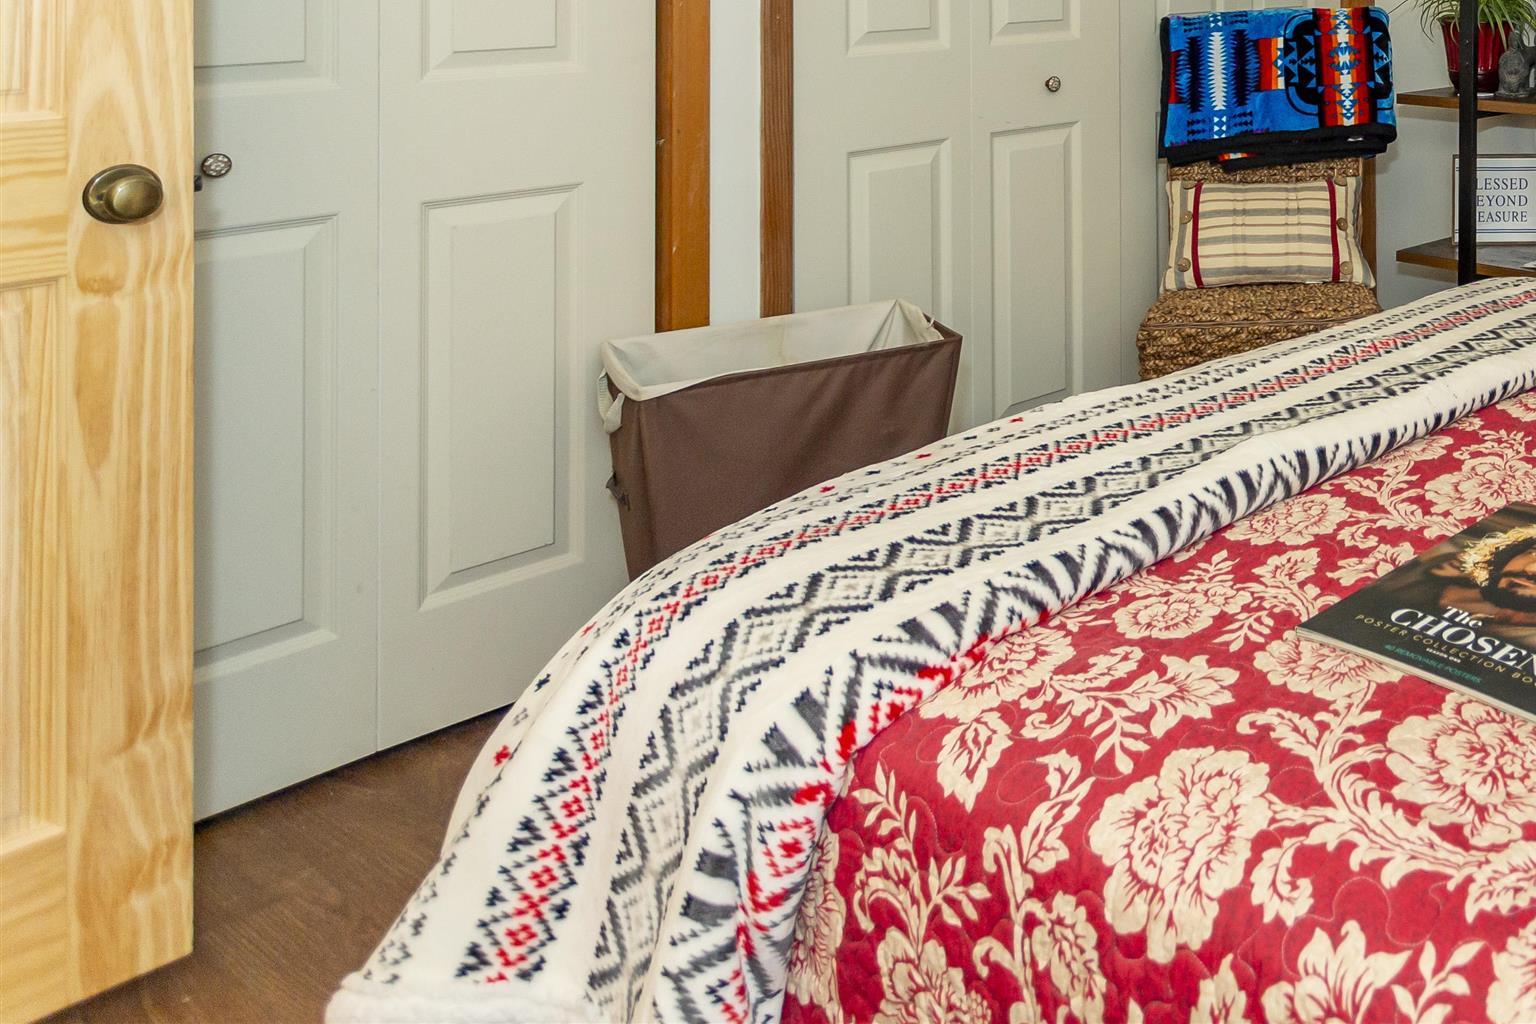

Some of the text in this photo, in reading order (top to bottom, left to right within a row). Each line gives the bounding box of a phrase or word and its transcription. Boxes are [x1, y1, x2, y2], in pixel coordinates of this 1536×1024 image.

[1476, 178, 1529, 190] LESSED
[1476, 195, 1528, 206] EYOND
[1478, 211, 1528, 222] EASURE
[1442, 606, 1483, 627] The
[1354, 614, 1408, 637] POSTER
[1412, 634, 1507, 674] COLLECTION
